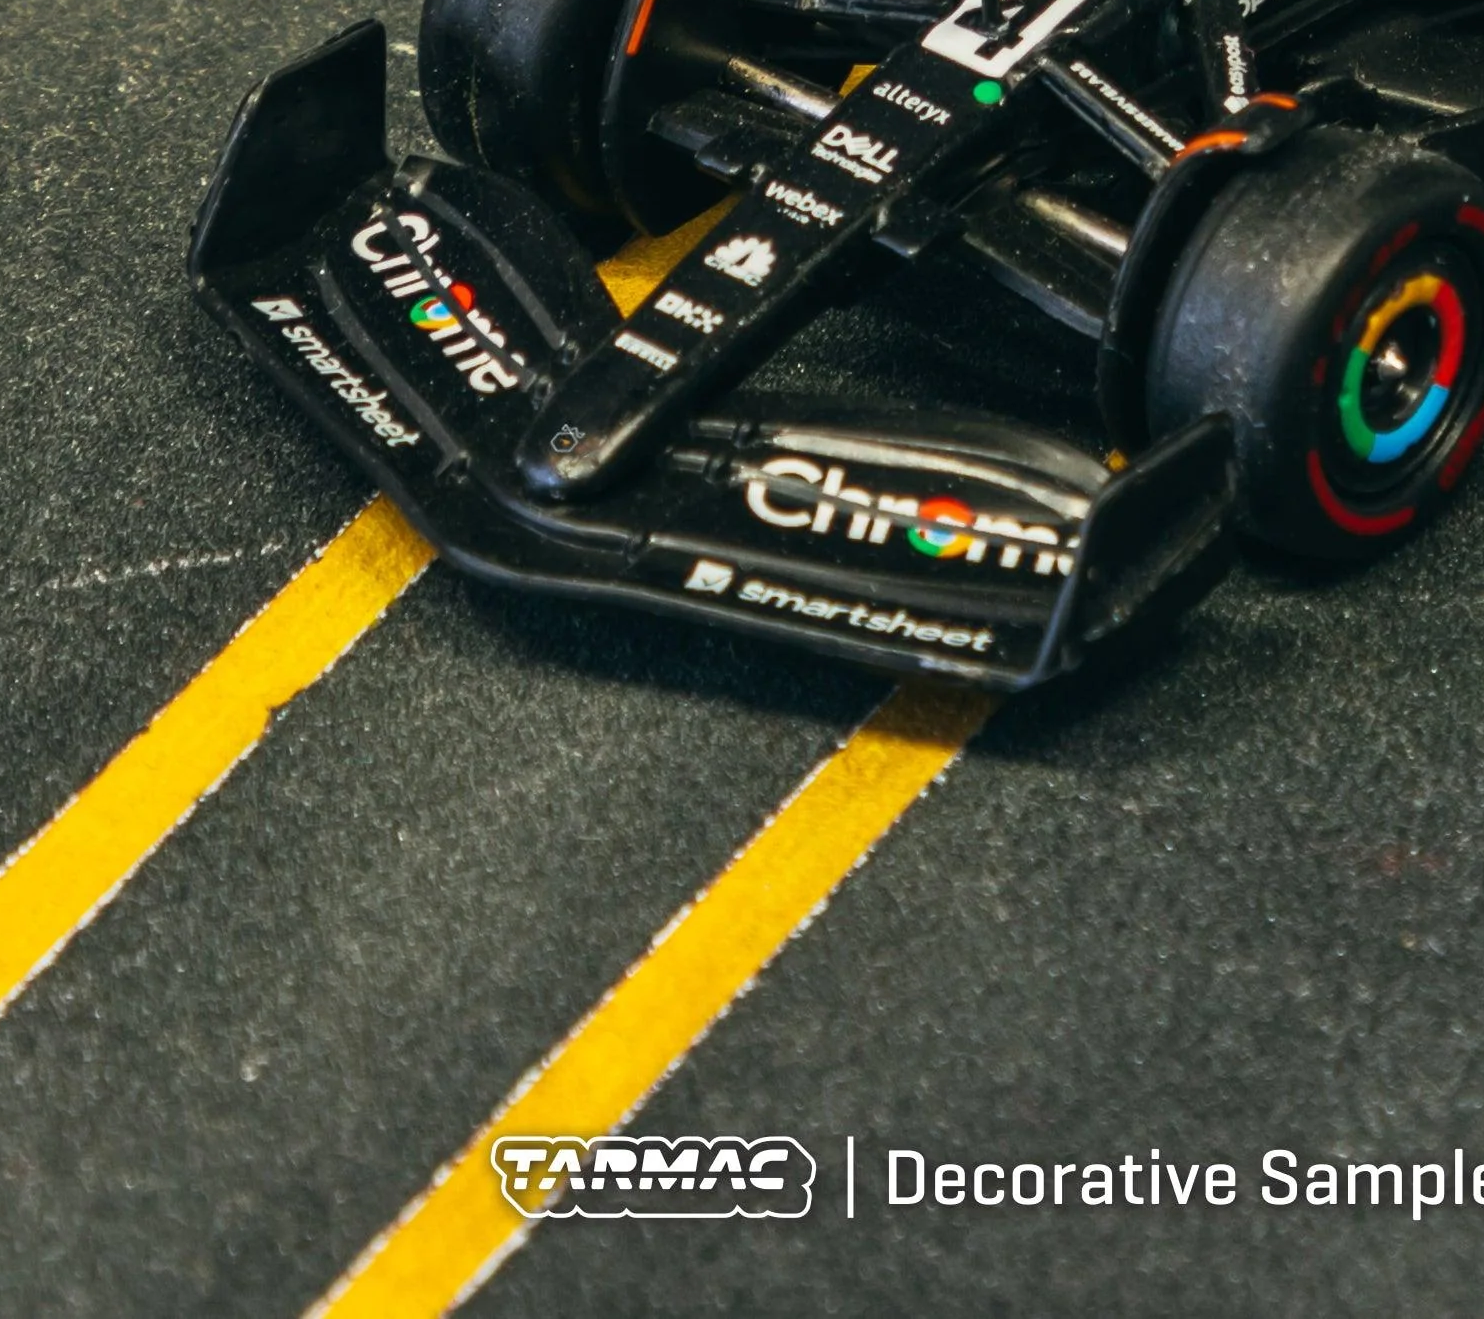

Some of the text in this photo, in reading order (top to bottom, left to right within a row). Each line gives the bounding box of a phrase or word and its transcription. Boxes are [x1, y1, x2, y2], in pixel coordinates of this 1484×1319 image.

[872, 81, 951, 126] alteryx
[820, 123, 899, 174] DELL
[765, 180, 845, 227] webex
[281, 324, 420, 448] smartsheet
[737, 578, 995, 652] smartsheet
